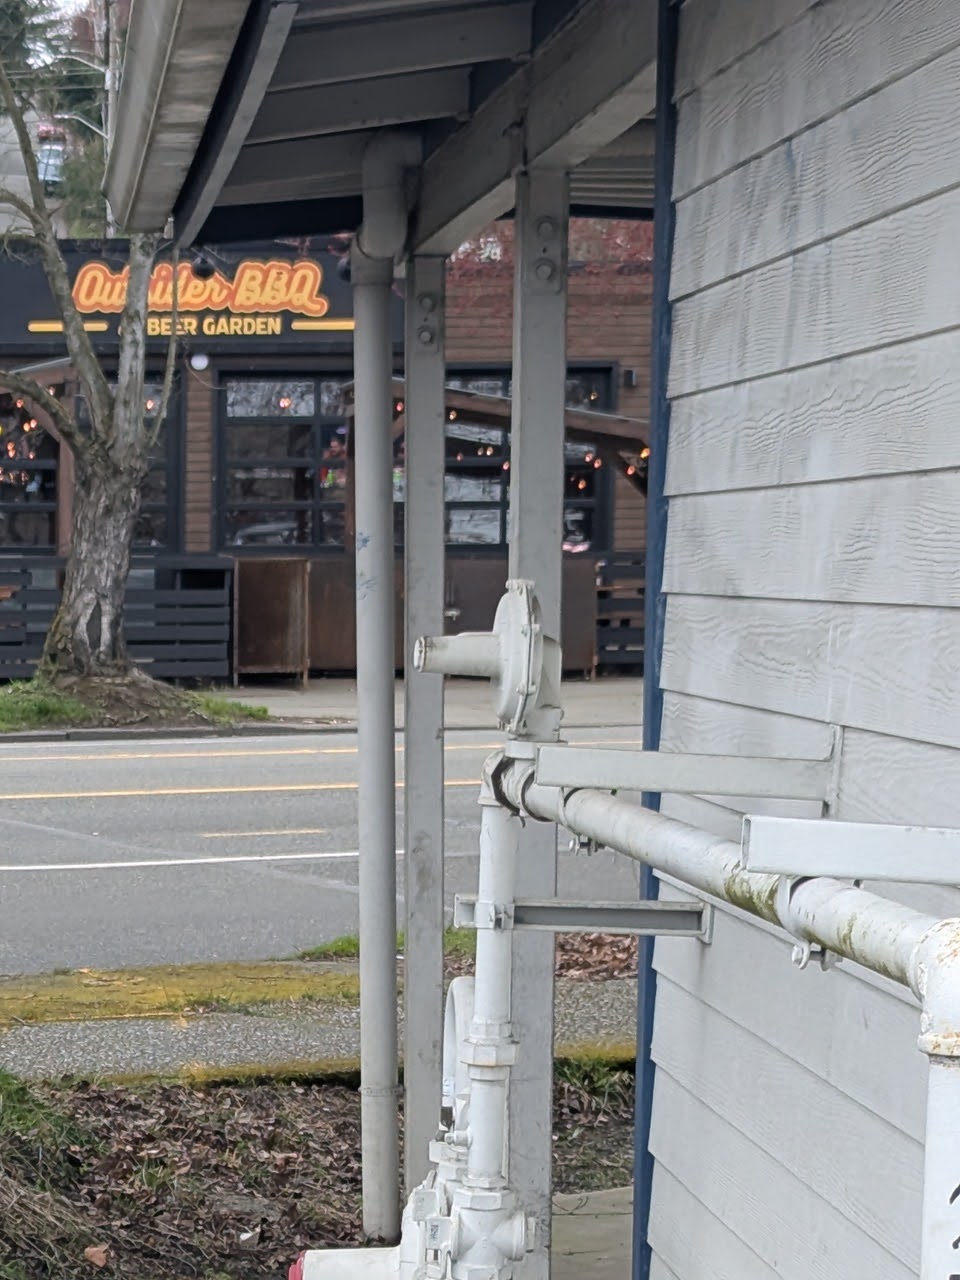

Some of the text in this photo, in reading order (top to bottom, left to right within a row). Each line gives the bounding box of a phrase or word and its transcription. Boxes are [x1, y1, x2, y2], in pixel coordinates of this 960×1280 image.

[233, 264, 324, 312] BBQ
[147, 317, 198, 336] BEER
[202, 317, 282, 336] GARDEN
